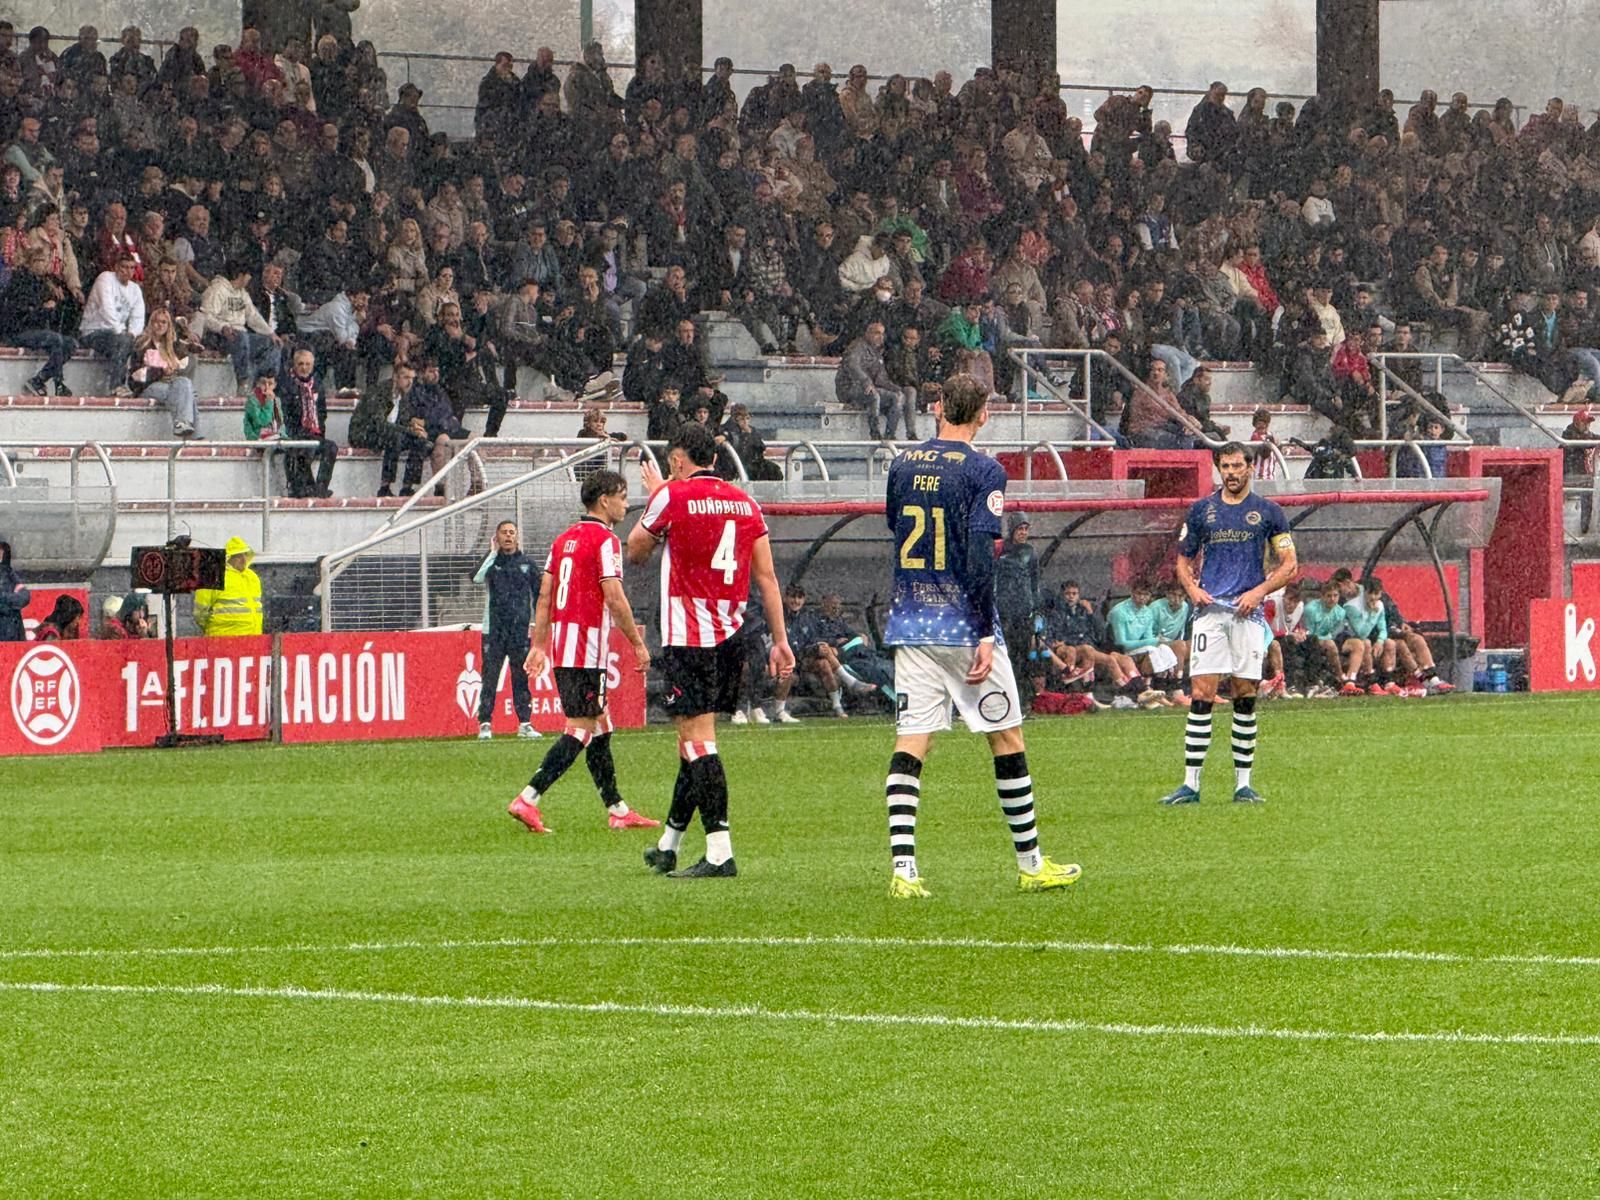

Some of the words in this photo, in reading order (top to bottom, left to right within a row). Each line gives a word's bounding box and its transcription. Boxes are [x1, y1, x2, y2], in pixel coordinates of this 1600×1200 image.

[902, 450, 939, 462] MMG
[913, 475, 941, 491] PERE
[901, 505, 946, 570] 21
[711, 519, 737, 585] 4
[556, 557, 573, 611] 8
[1193, 633, 1207, 653] 10
[34, 680, 57, 693] RF
[173, 641, 406, 731] FEDERACIÓN
[34, 697, 57, 710] EF
